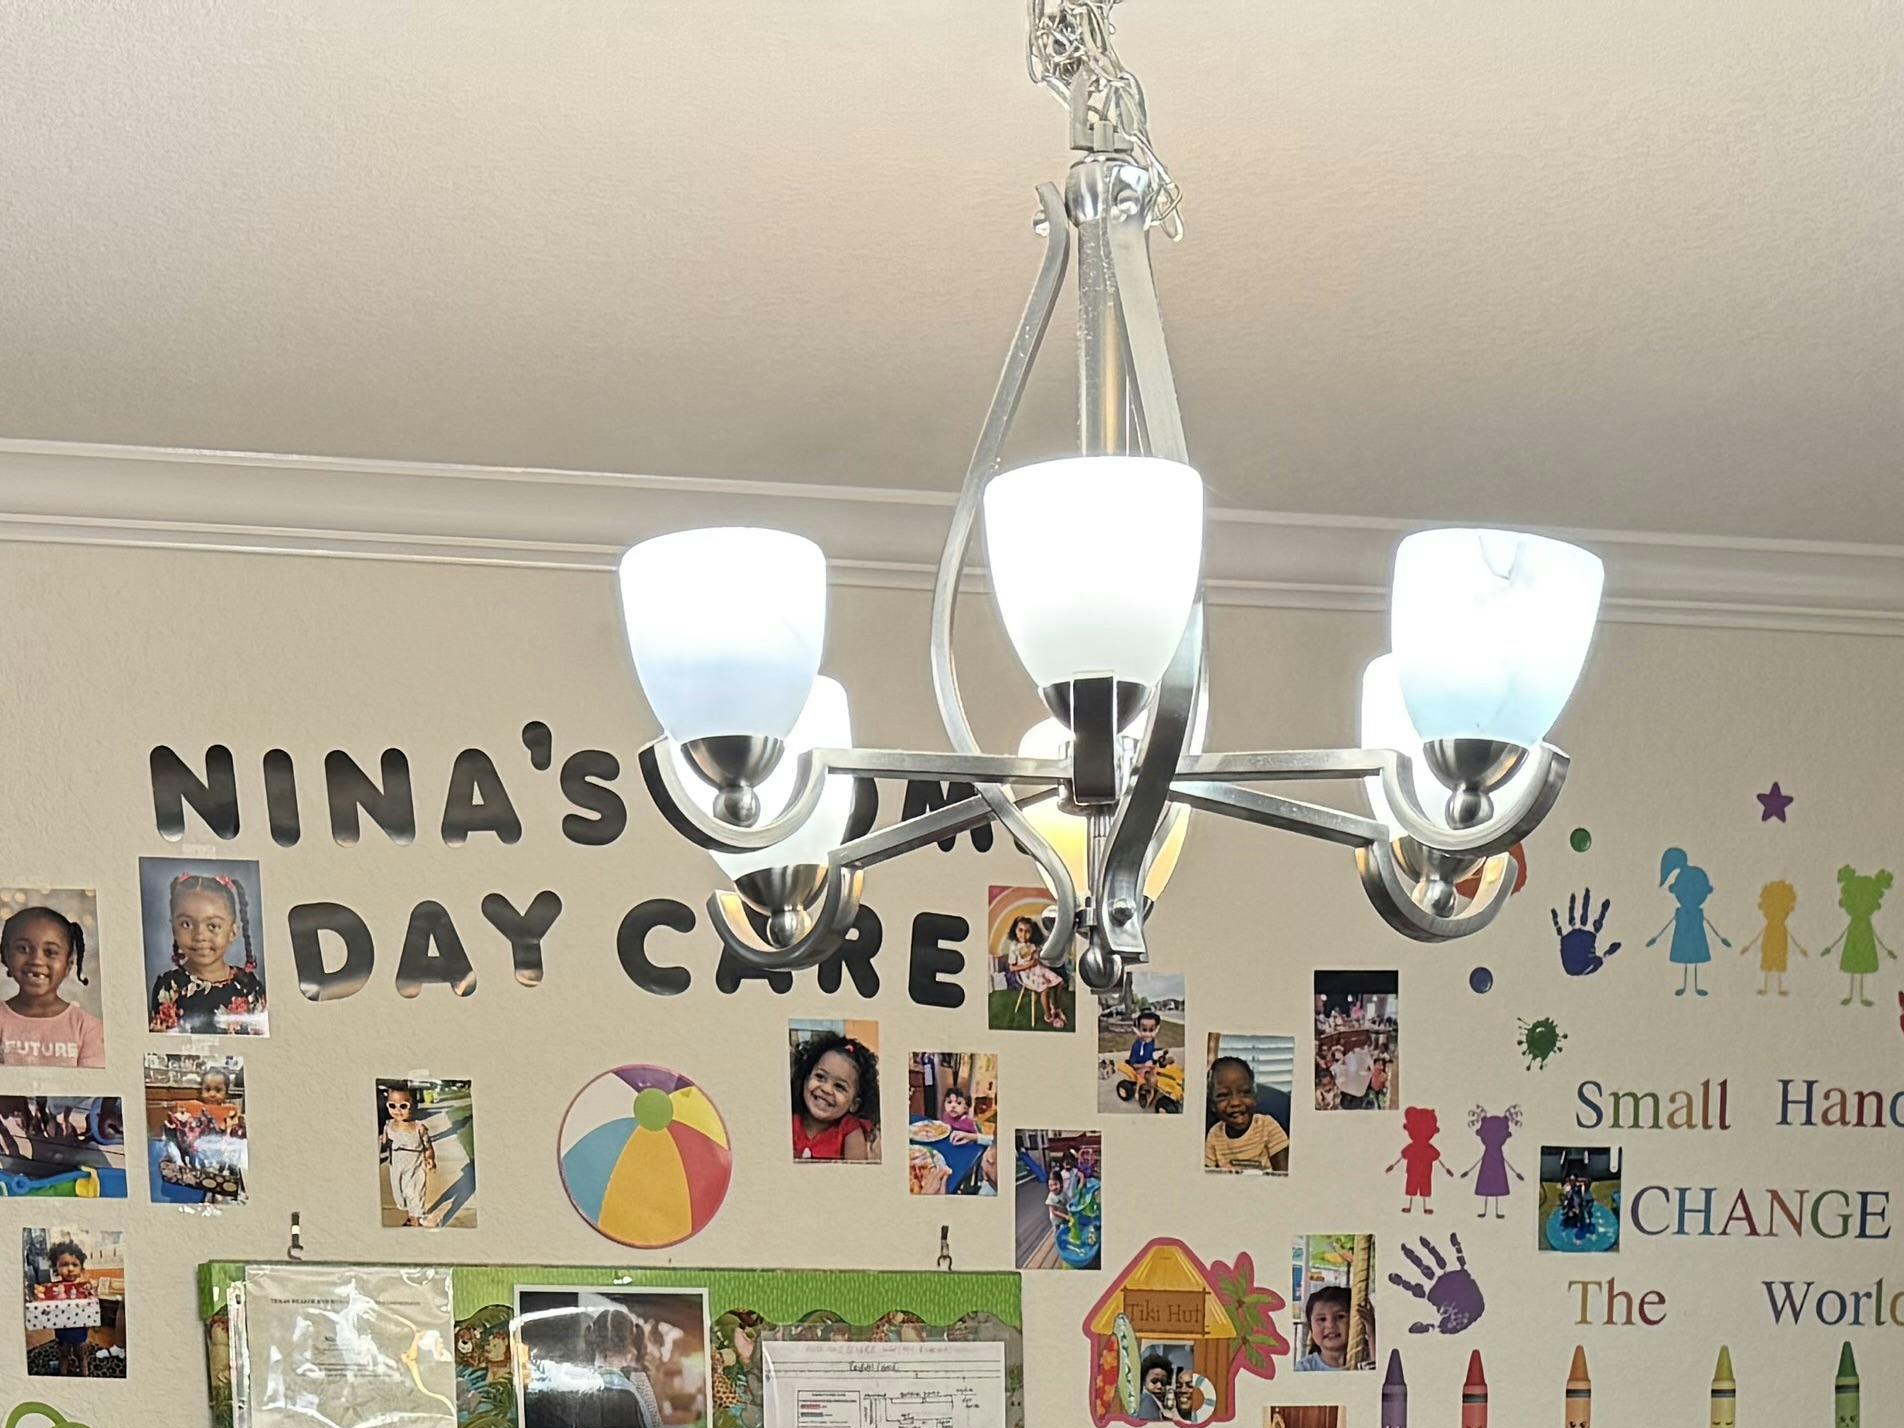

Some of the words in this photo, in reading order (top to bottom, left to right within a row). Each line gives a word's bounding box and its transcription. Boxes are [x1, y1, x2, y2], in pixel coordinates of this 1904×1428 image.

[149, 720, 627, 848] NINA'S
[288, 890, 562, 1002] DAY
[5, 1040, 79, 1058] FUTURE
[1575, 1078, 1731, 1131] Small
[1630, 1185, 1892, 1241] CHANGE
[1127, 1301, 1161, 1321] Tiki
[1168, 1305, 1201, 1323] Hut
[1568, 1279, 1667, 1327] The
